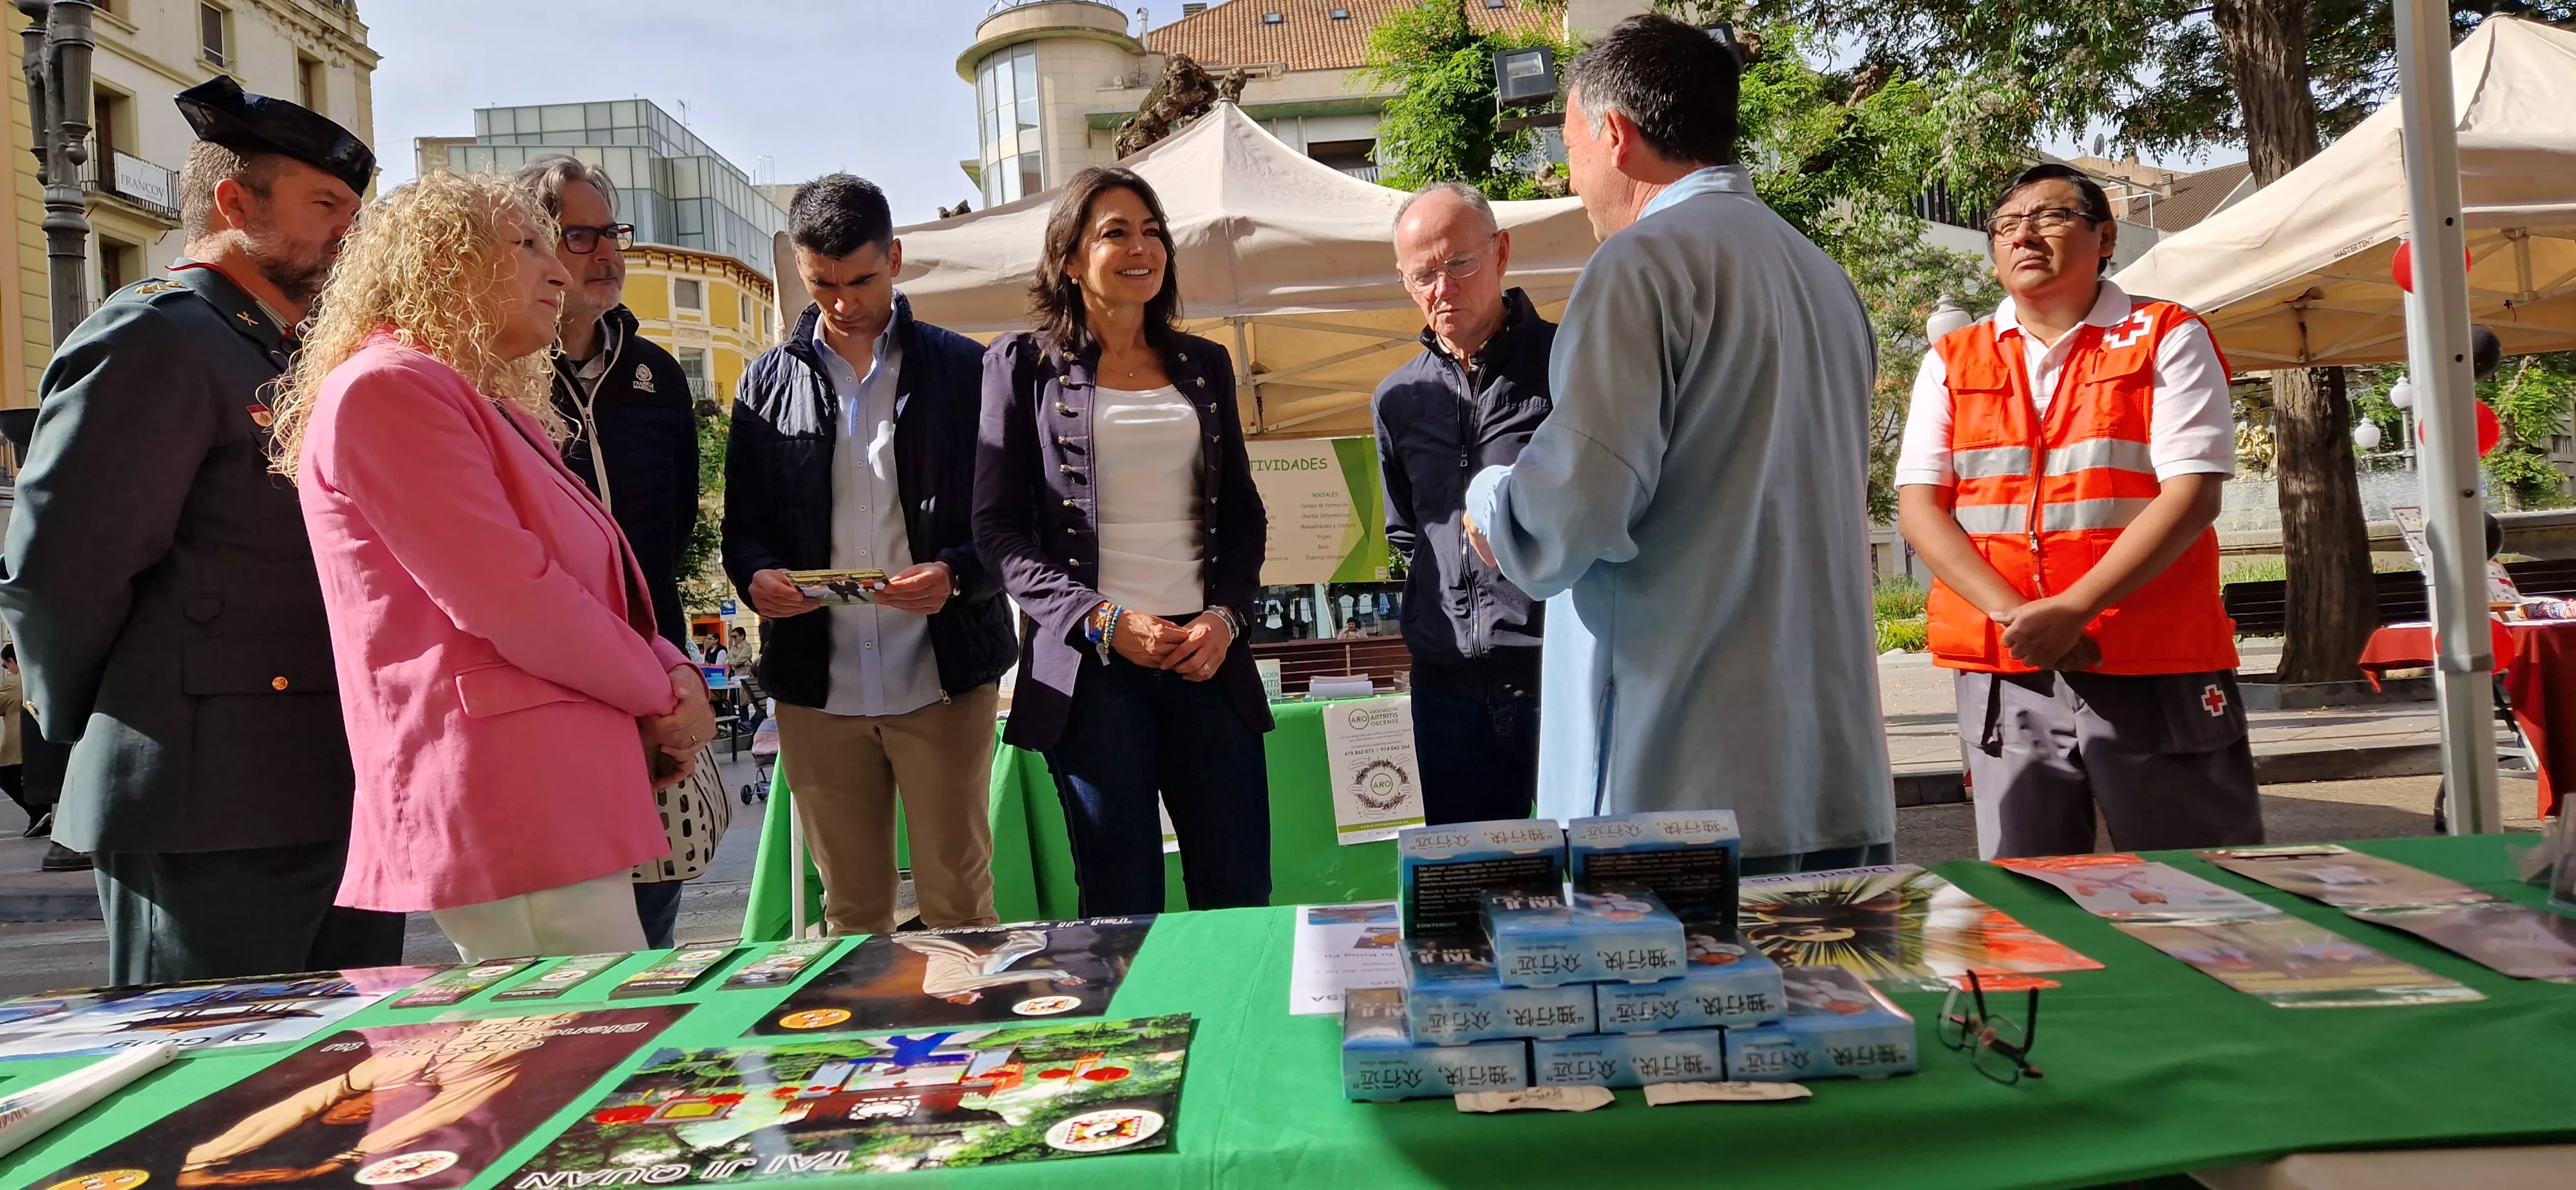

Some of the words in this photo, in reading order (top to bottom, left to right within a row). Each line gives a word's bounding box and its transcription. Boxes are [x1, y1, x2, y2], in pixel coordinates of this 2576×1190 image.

[2333, 236, 2374, 259] MASTERTENT
[1249, 458, 1328, 471] TIVIDADES
[1264, 679, 1280, 688] RITIS
[1370, 712, 1399, 721] ARTRITIS
[1373, 780, 1391, 789] ARO
[1751, 876, 1791, 885] los
[699, 1157, 759, 1180] JI
[764, 1150, 855, 1175] TAI
[515, 1163, 692, 1190] QUAN
